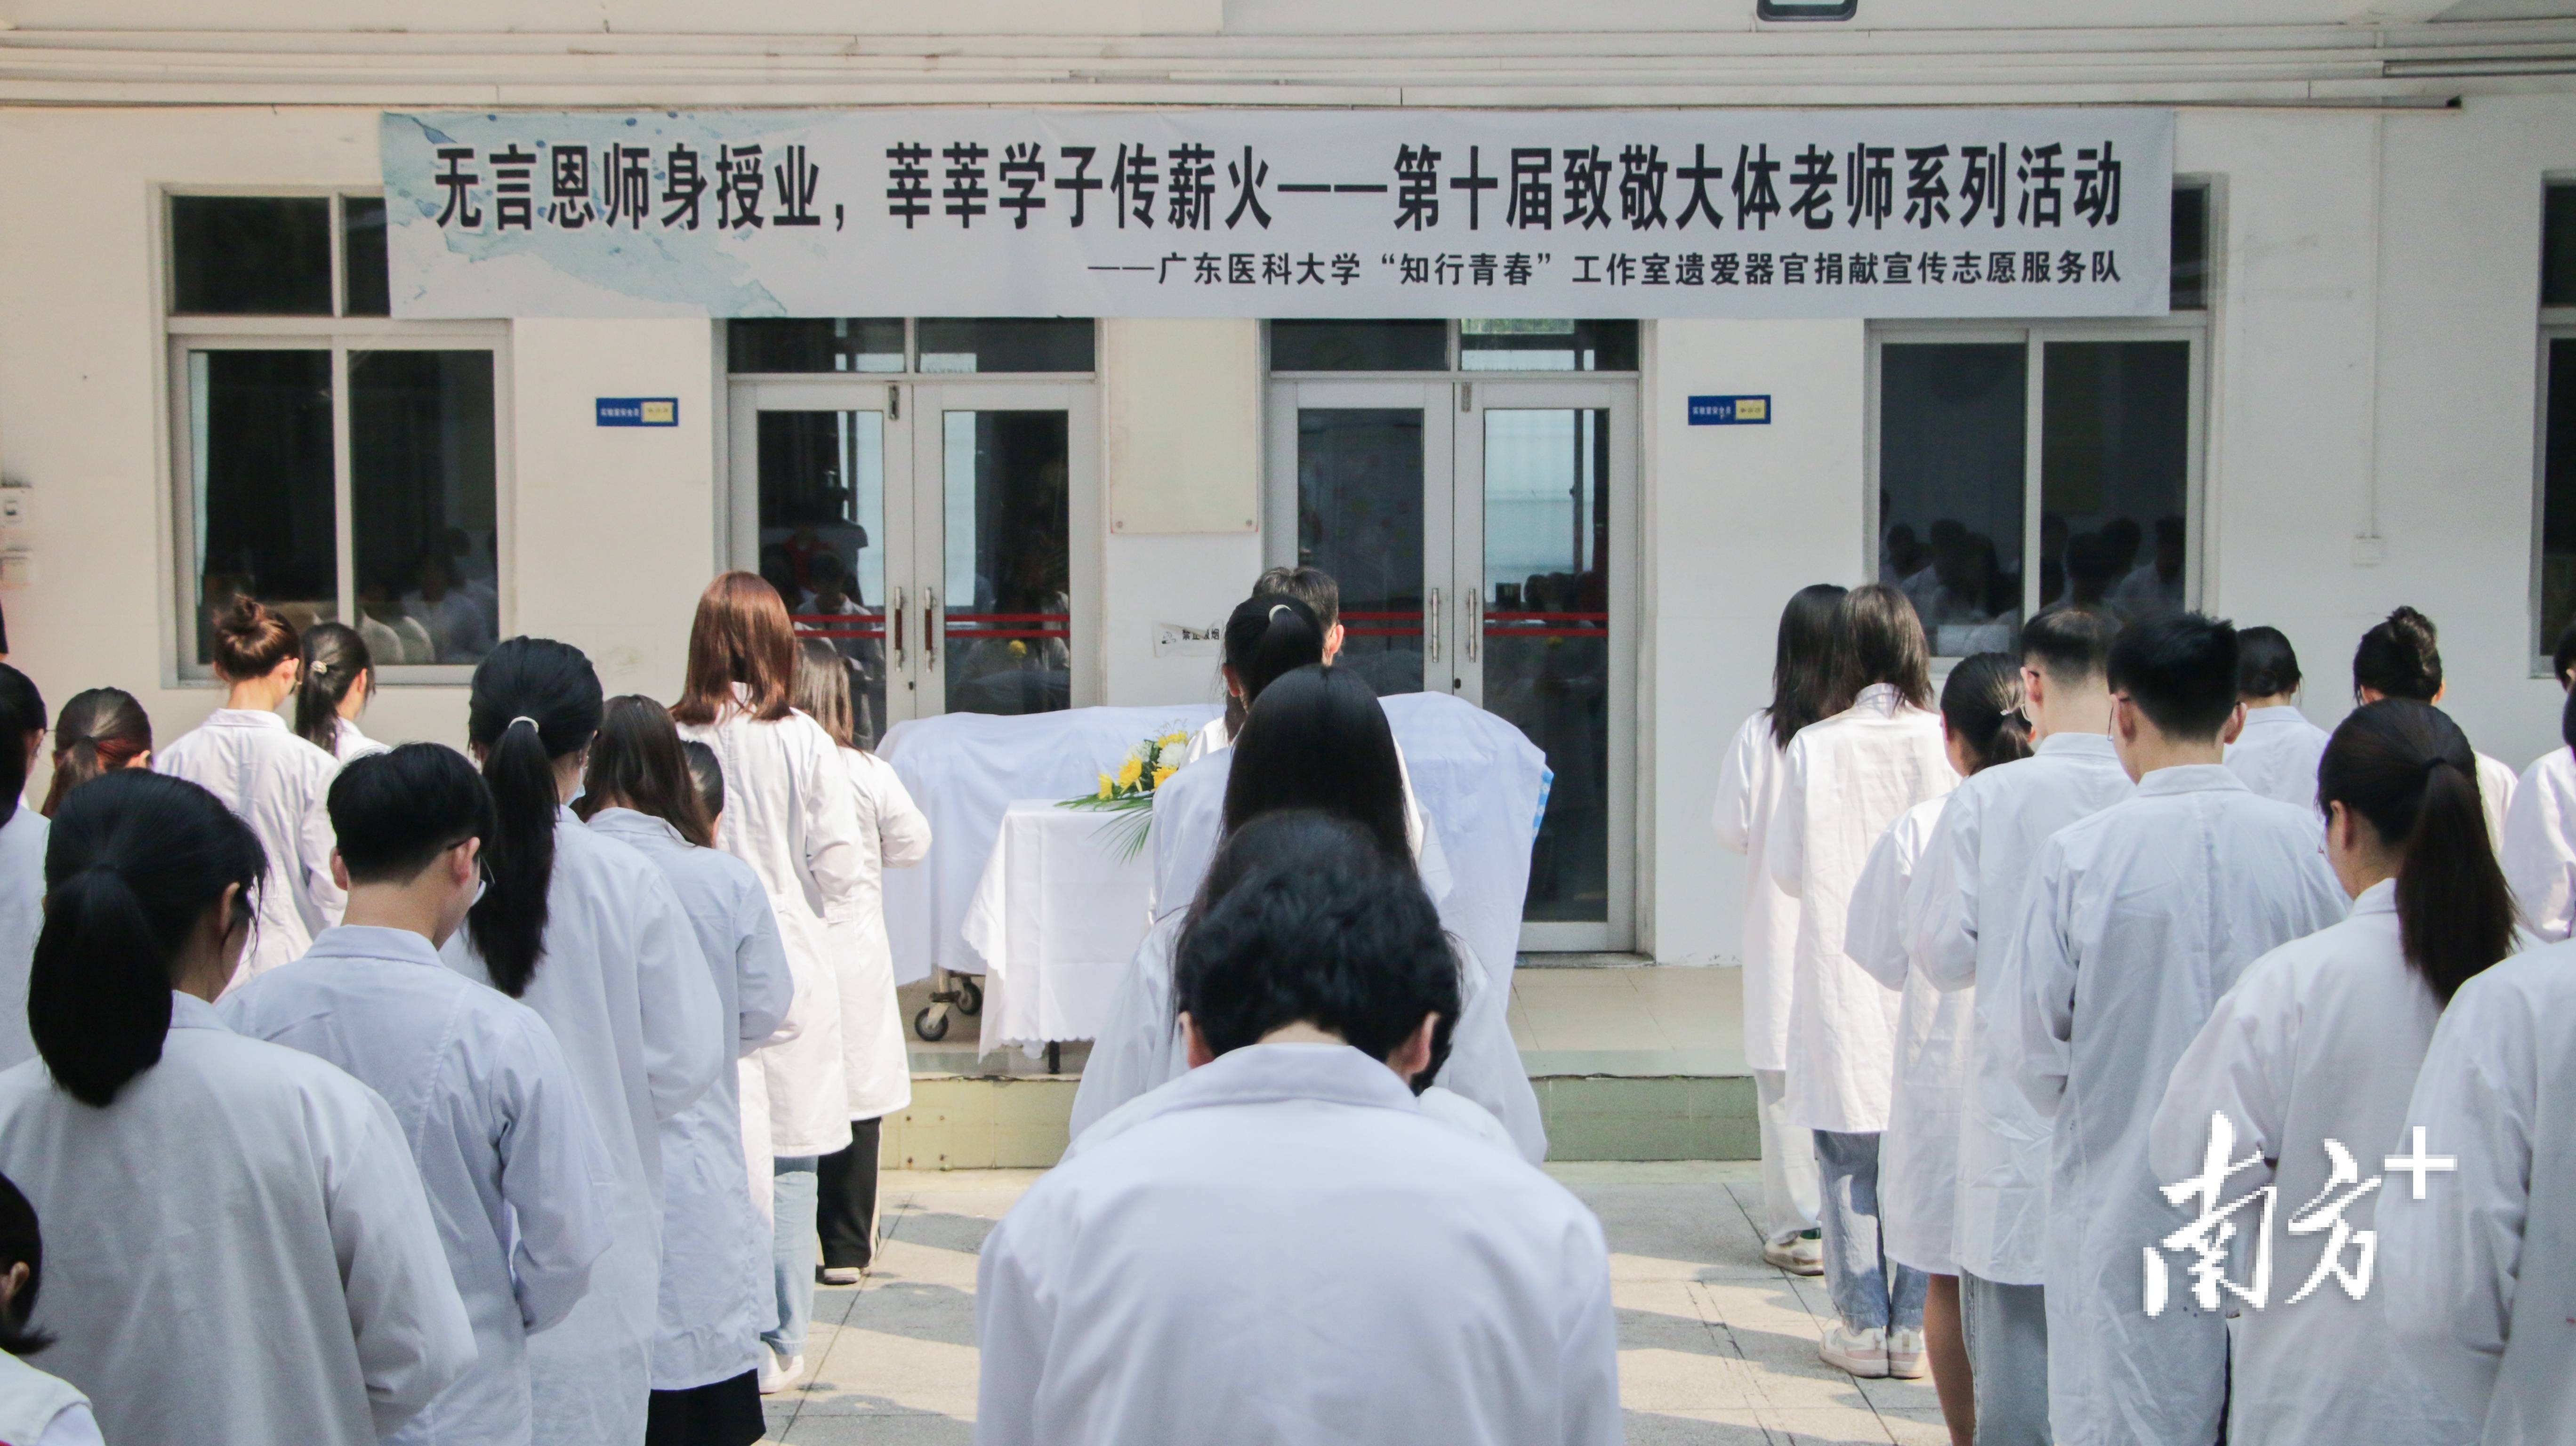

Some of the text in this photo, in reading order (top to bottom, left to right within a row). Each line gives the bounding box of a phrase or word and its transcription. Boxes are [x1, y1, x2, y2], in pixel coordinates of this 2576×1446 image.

[435, 140, 2121, 232] 无言恩师身授业，莘莘学子传薪火——第十届致敬大体老师系列活动
[1087, 250, 2121, 286] ——广东医科大学“知行青春”工作室遗爱器官捐献宣传志愿服务队
